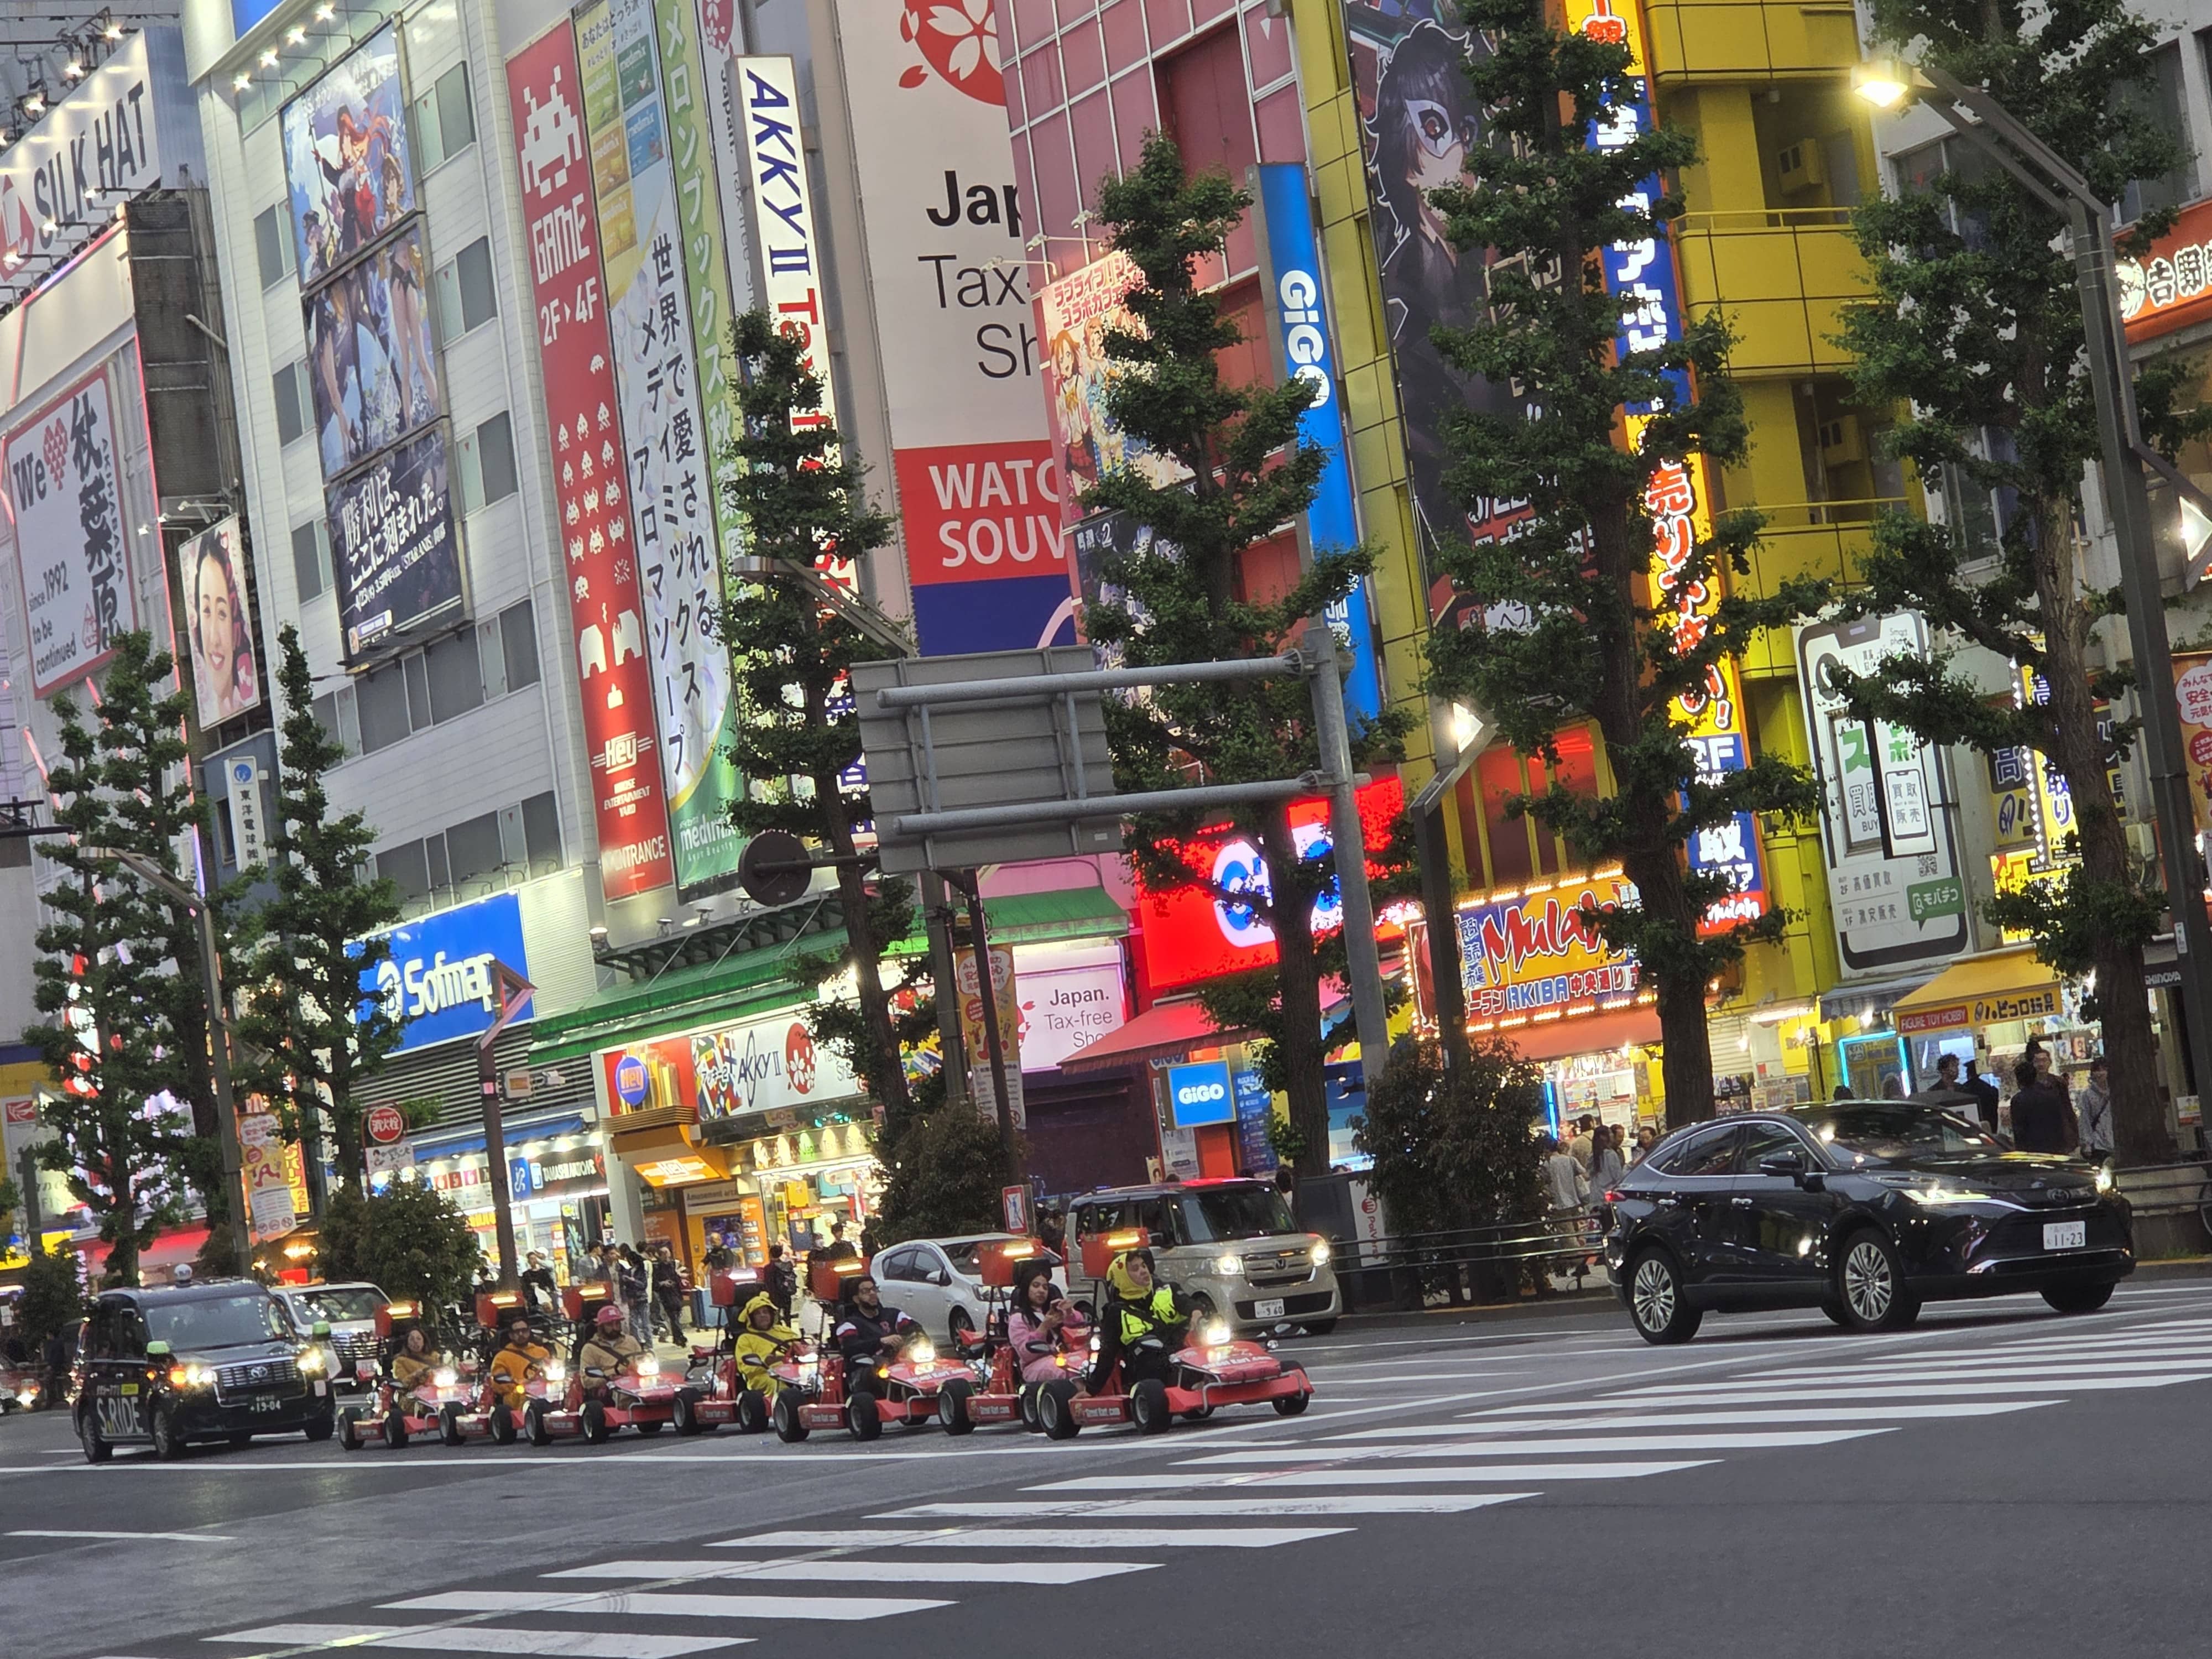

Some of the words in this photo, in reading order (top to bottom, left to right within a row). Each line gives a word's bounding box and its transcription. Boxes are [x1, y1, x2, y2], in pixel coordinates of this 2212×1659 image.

[33, 130, 94, 250] SILK
[94, 79, 147, 201] HAT
[747, 67, 806, 239] AKKY
[531, 192, 592, 285] GAME
[2146, 239, 2212, 308] 吉野
[541, 298, 561, 346] 2F
[575, 276, 598, 324] 4F
[13, 451, 47, 513] We
[28, 592, 46, 613] since
[43, 560, 70, 602] 1992
[32, 625, 43, 646] to
[40, 616, 53, 640] be
[36, 631, 77, 677] continued
[1892, 782, 1918, 800] 買取
[1861, 818, 1879, 832] BUY
[1896, 807, 1921, 825] 販売
[1924, 886, 1959, 906] モバデコ
[403, 951, 496, 1016] Sofmap
[1049, 985, 1110, 1009] Japan.
[1044, 1010, 1113, 1031] Tax-free
[1901, 1016, 1926, 1030] FIGURE
[1926, 1013, 1941, 1027] TOY
[1942, 1009, 1966, 1024] HOBBY
[737, 1051, 772, 1084] AKKY
[1178, 1083, 1225, 1105] GiGO
[371, 1117, 400, 1134] 消火栓
[297, 1191, 307, 1212] 2F
